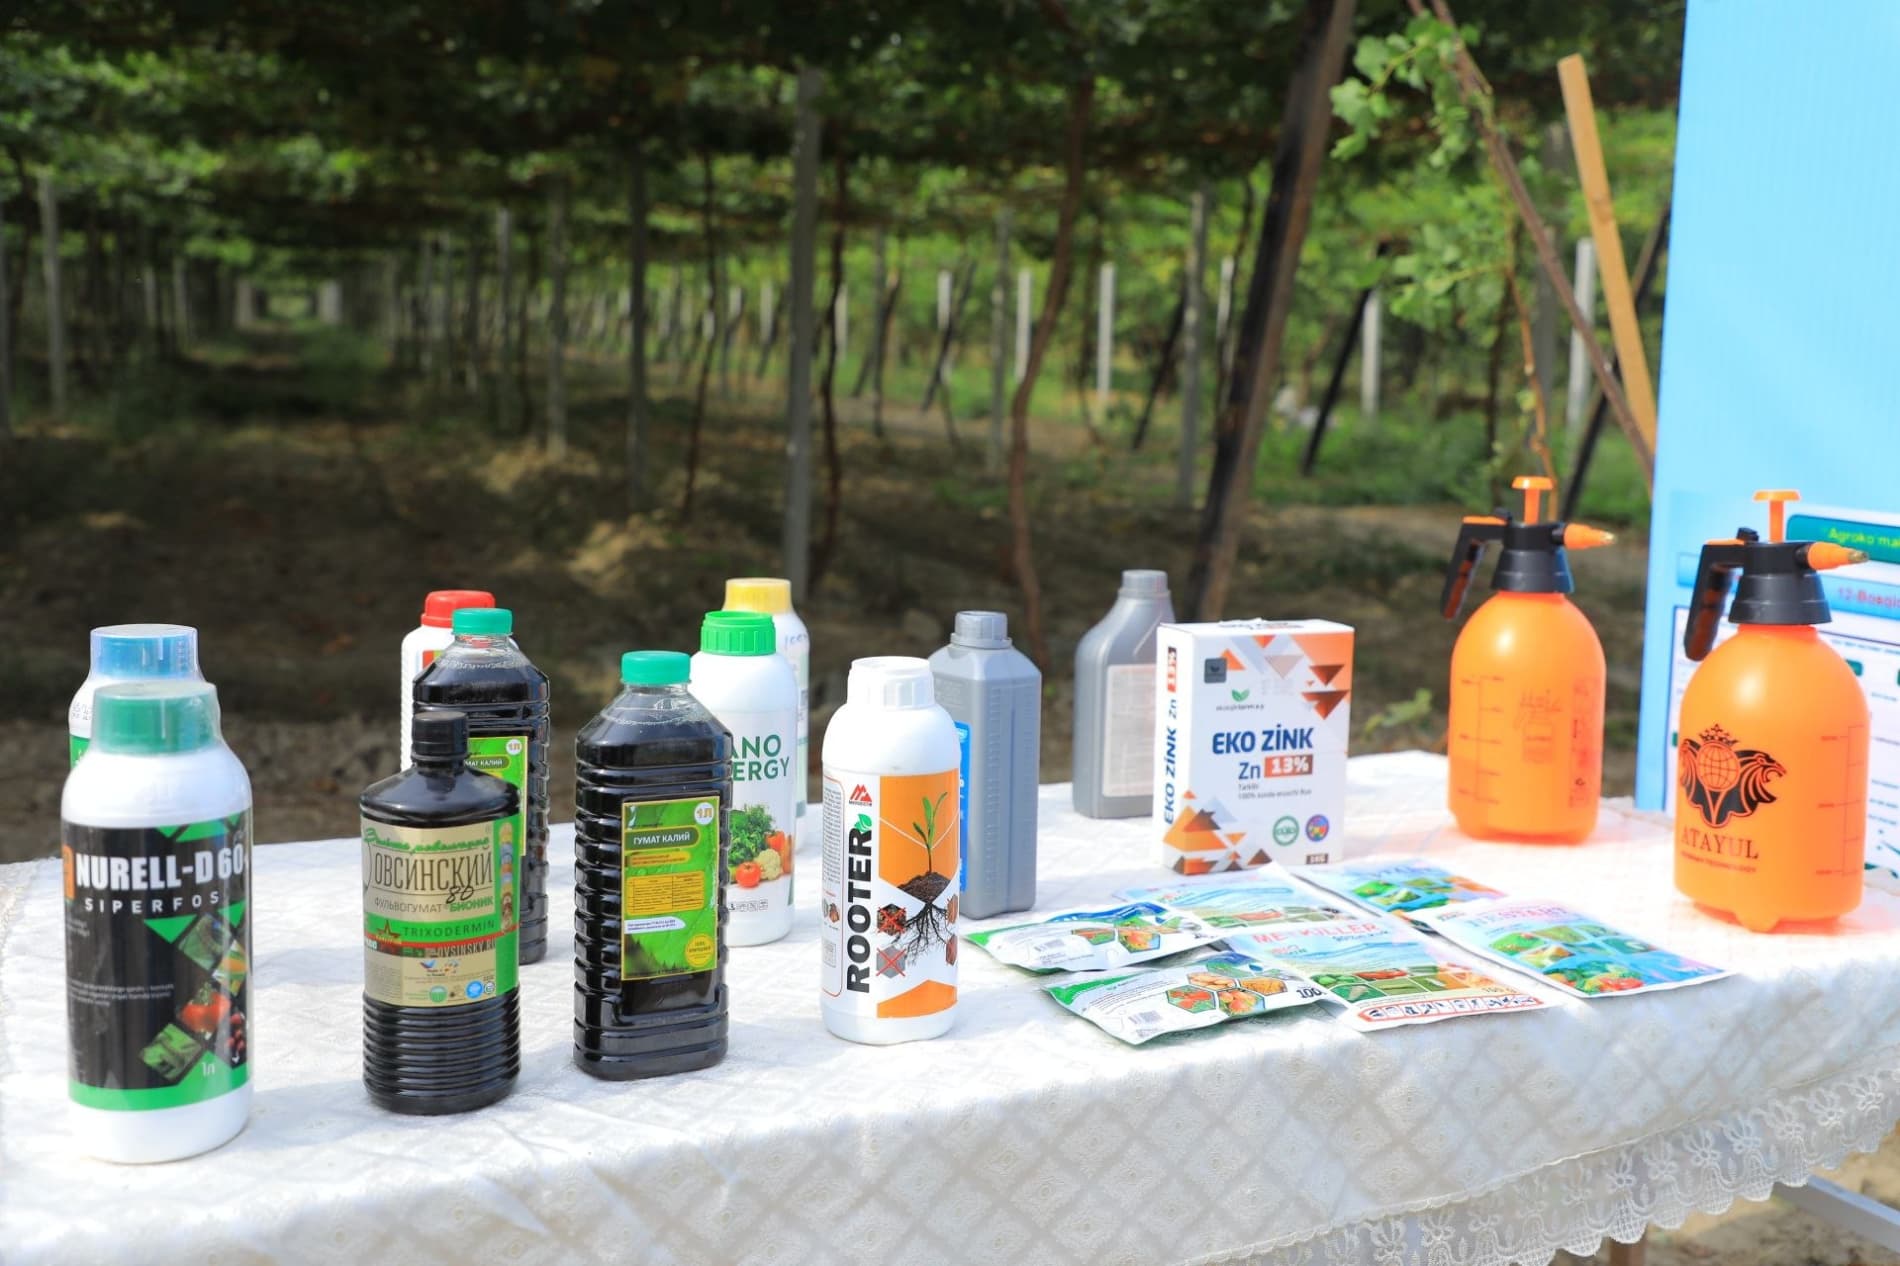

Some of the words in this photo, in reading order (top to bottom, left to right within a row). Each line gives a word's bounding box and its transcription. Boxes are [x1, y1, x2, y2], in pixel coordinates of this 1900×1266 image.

[1213, 731, 1256, 754] EKO
[733, 756, 790, 780] ERGY
[1238, 762, 1260, 780] Zn
[1271, 757, 1309, 774] 13%
[1164, 783, 1175, 825] EKO
[634, 835, 661, 845] ГУМАТ
[663, 832, 690, 843] КАЛИЙ
[1681, 826, 1758, 860] ATAYUL
[76, 851, 213, 890] NURELL-D
[374, 842, 493, 891] ОВСИНСКИЙ
[85, 891, 219, 914] SIPERFOS
[374, 897, 442, 912] ФУЛЬВОГУМАТ
[846, 827, 872, 993] ROOTER
[404, 920, 495, 937] TRIXODERMIN
